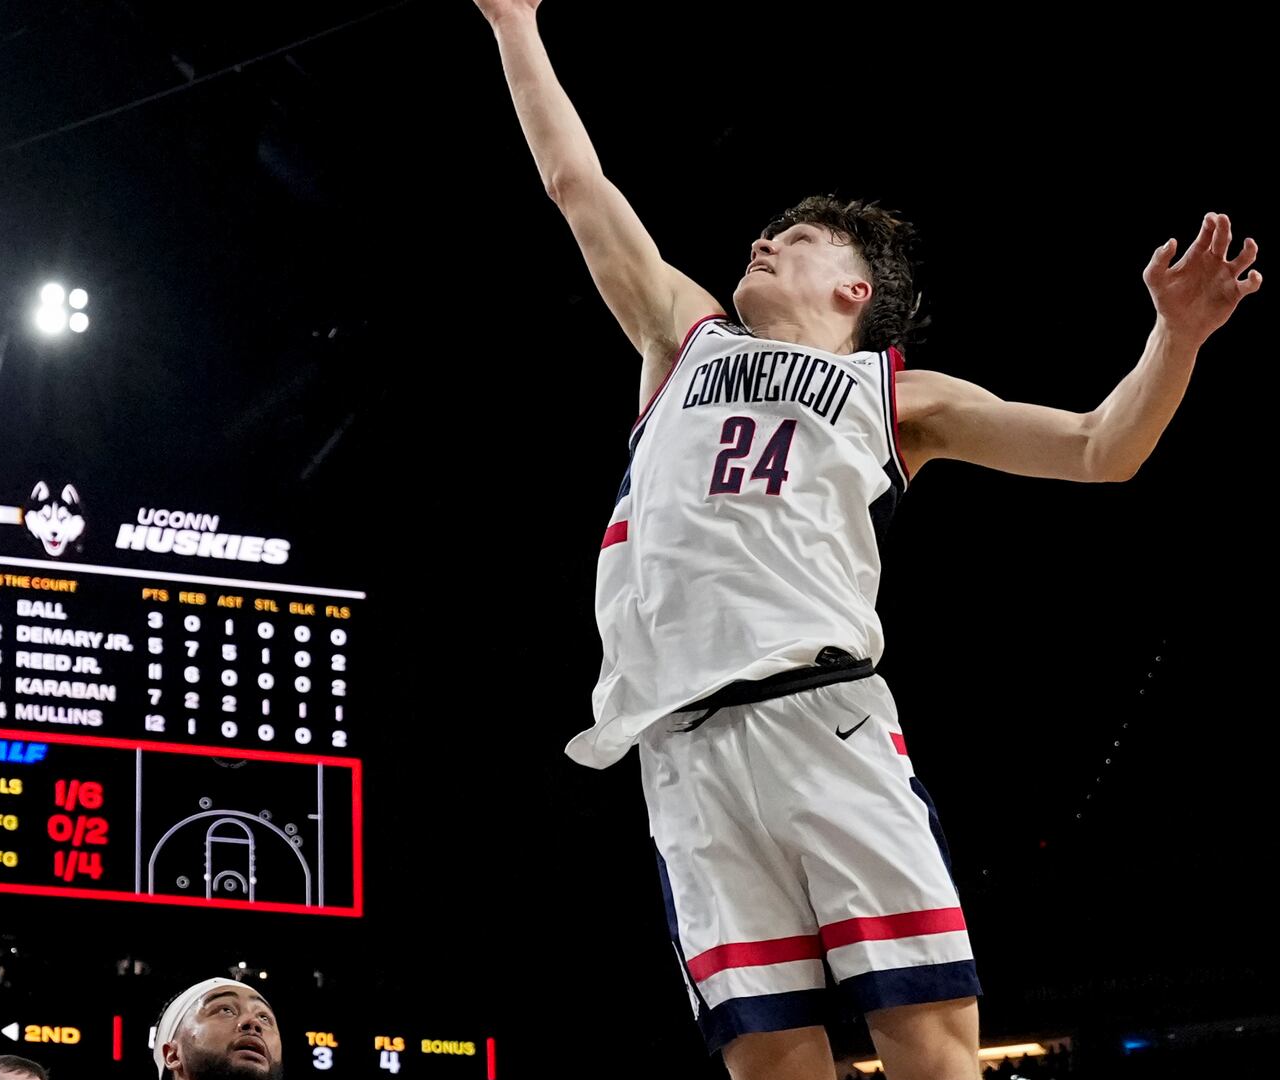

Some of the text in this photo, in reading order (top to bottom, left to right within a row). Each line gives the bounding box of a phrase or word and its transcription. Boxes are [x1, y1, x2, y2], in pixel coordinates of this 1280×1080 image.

[682, 351, 858, 426] CONNECTICUT
[708, 416, 798, 496] 24
[135, 508, 219, 534] UCONN
[115, 521, 290, 564] HUSKIES
[5, 574, 30, 588] THE
[31, 578, 77, 592] COURT
[142, 588, 350, 619] PTS REB AST STL BLK FLS
[17, 600, 67, 620] BALL
[148, 612, 163, 628] 3
[184, 615, 200, 632] 0
[258, 622, 274, 639] 0
[294, 626, 310, 642] 0
[331, 629, 346, 645] 0
[16, 625, 103, 648] DEMARY
[104, 634, 133, 651] JR.
[148, 637, 163, 654] 5
[185, 641, 199, 657] 7
[222, 644, 237, 660] 5
[295, 651, 311, 667] 0
[16, 651, 71, 671] REED
[72, 656, 101, 674] JR.
[149, 663, 162, 680] 11
[184, 666, 199, 683] 6
[221, 670, 237, 686] 0
[258, 673, 274, 689] 0
[295, 676, 311, 692] 0
[16, 677, 116, 701] KARABAN
[148, 689, 161, 705] 7
[15, 703, 102, 726] MULLINS
[145, 715, 165, 732] 12
[222, 721, 237, 738] 0
[258, 725, 274, 741] 0
[295, 728, 311, 744] 0
[55, 780, 103, 811] 1/6
[48, 814, 108, 846] 0/2
[54, 850, 103, 881] 1/4
[24, 1025, 80, 1044] 2ND
[305, 1032, 475, 1056] TOL FLS BONUS
[313, 1047, 400, 1074] 3 4
